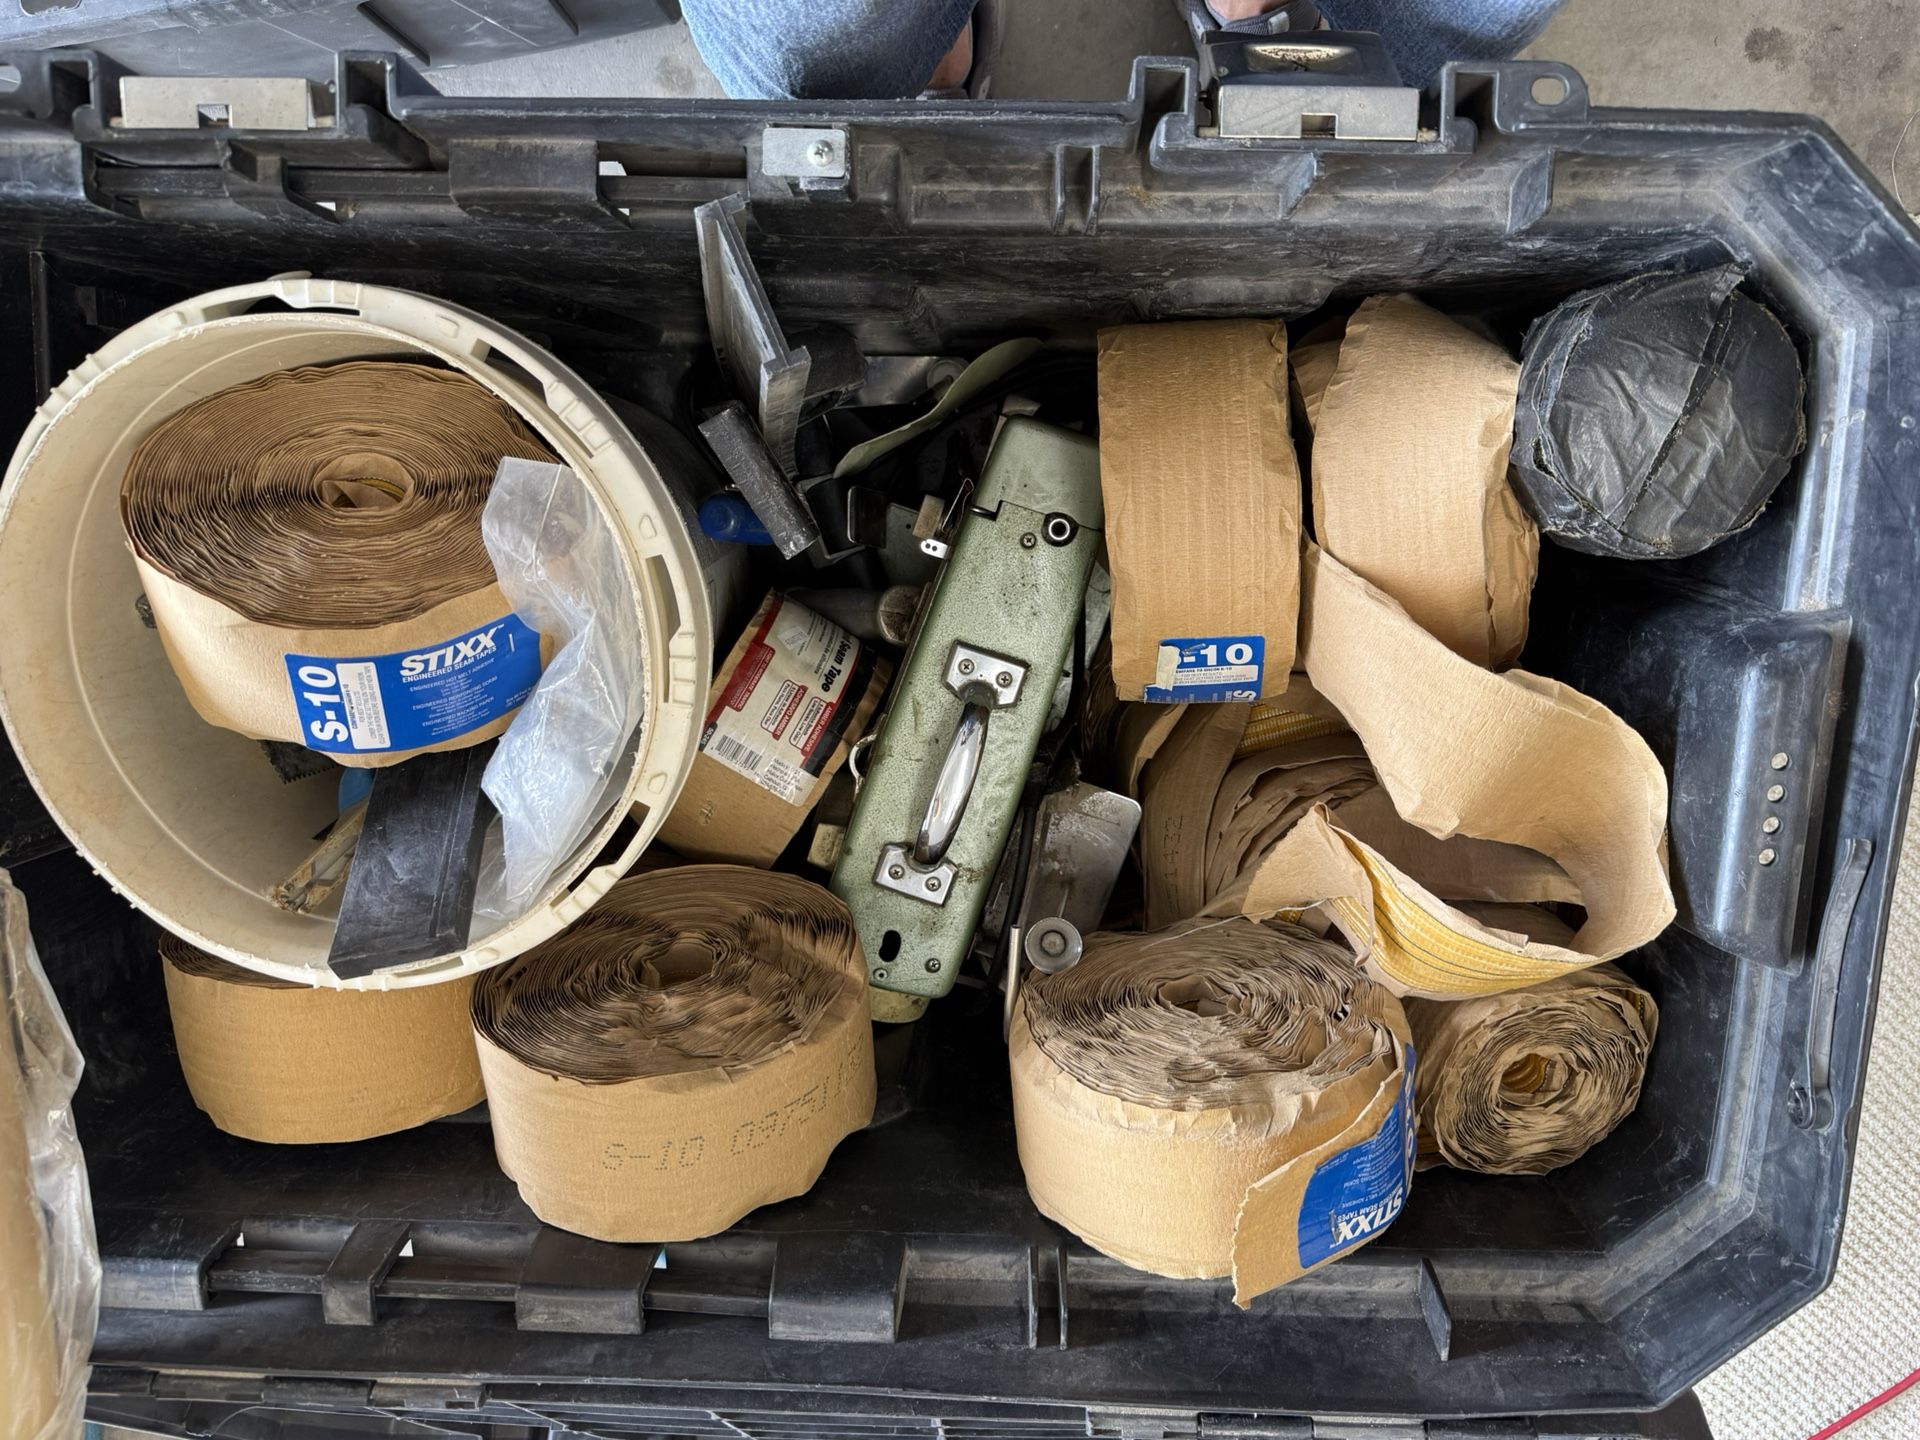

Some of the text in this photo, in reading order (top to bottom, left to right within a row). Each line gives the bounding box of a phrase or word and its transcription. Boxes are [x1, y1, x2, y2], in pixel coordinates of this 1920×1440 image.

[402, 646, 496, 683] ENGINEERED SEAM TAPES
[1178, 643, 1253, 666] -10
[410, 679, 445, 692] ENGINEERED
[446, 676, 458, 684] HOT
[458, 670, 471, 680] MELT
[817, 664, 841, 694] Tape
[298, 666, 349, 742] S-10
[413, 698, 448, 711] ENGINEERED
[803, 723, 823, 753] ADHESIVE
[603, 1136, 705, 1171] S-10
[1337, 1209, 1359, 1222] TAPES
[1358, 1203, 1379, 1217] SEAM
